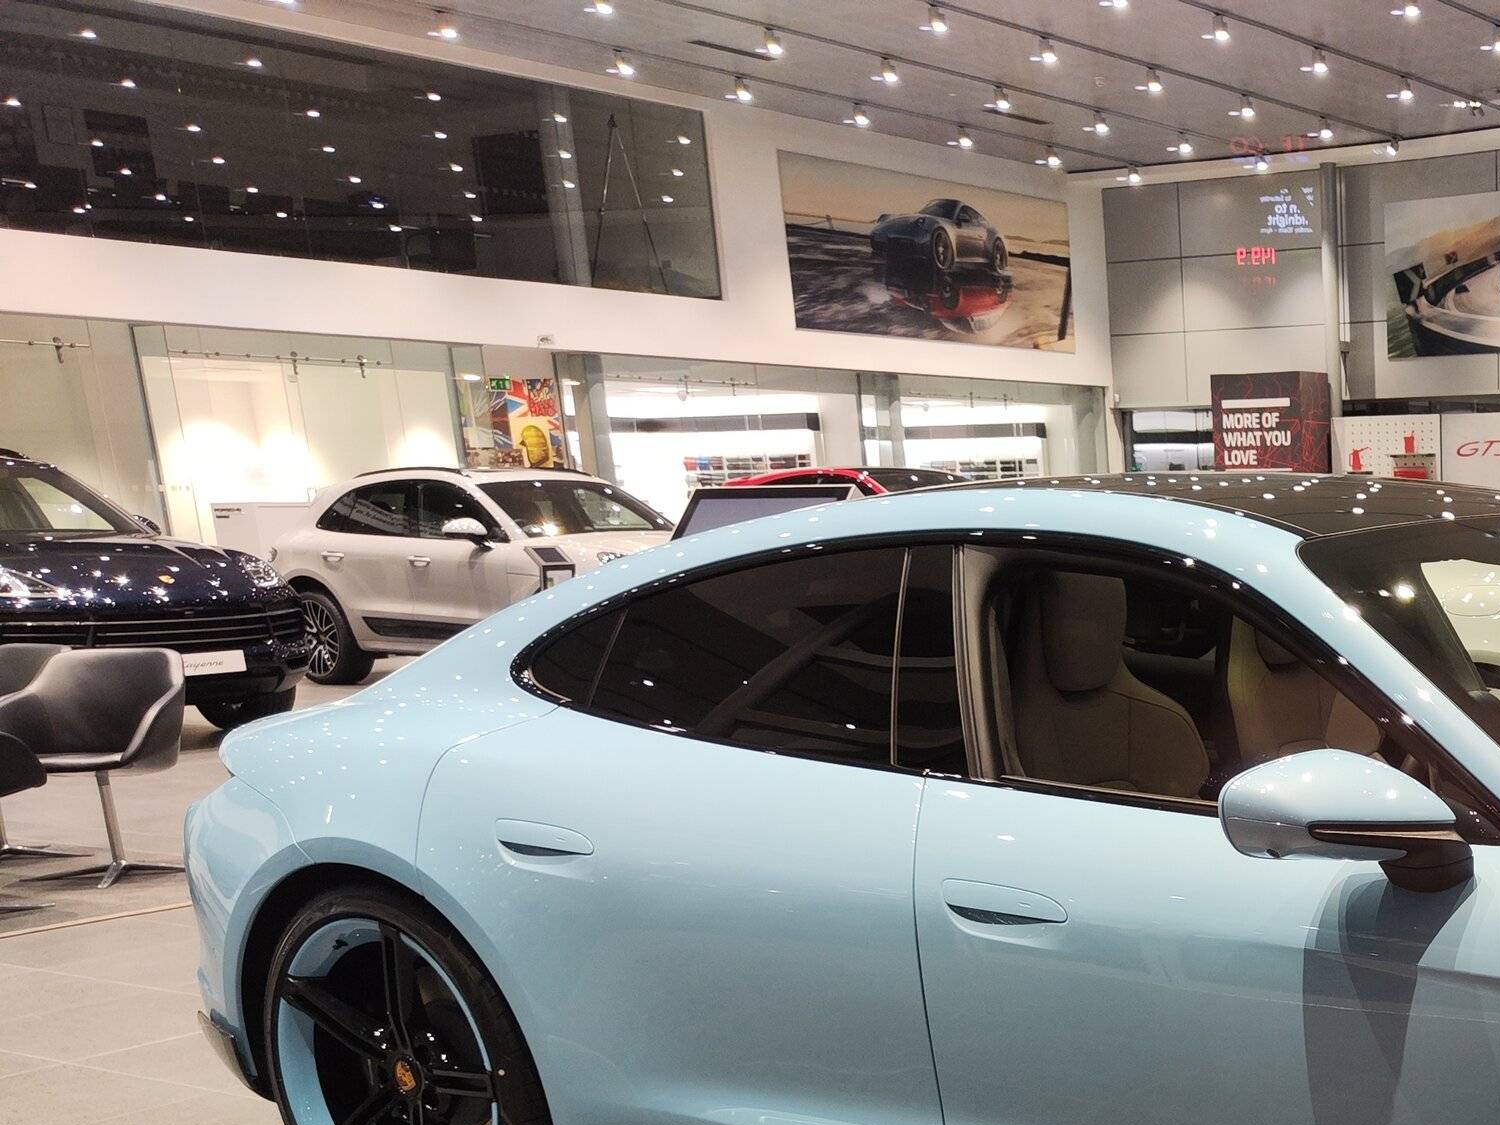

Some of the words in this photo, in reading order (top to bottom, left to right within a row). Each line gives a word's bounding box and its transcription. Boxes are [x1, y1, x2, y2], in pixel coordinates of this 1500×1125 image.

[1222, 412, 1261, 430] MORE
[1261, 412, 1280, 428] OF
[1223, 431, 1263, 447] WHAT
[1264, 430, 1292, 446] YOU
[1223, 449, 1258, 465] LOVE
